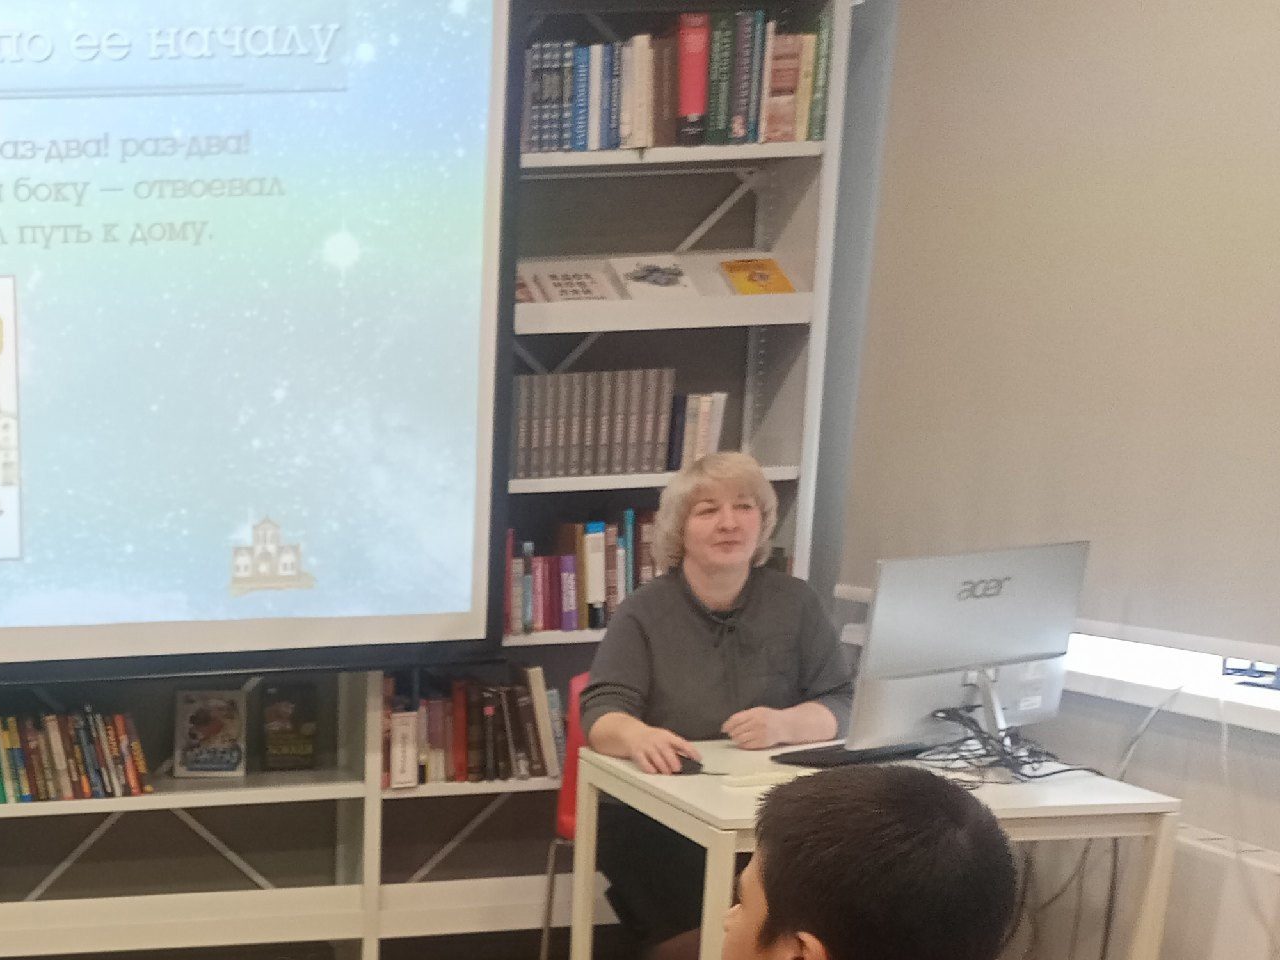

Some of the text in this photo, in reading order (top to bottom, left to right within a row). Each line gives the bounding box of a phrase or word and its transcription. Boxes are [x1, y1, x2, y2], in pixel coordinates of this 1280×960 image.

[71, 27, 132, 61] ее
[147, 21, 341, 64] началу
[119, 129, 251, 163] раз-два!
[13, 177, 91, 207] боку
[133, 175, 287, 200] отвоевал
[17, 221, 93, 251] путь
[101, 222, 121, 245] к
[129, 219, 214, 251] дому.
[957, 576, 1012, 600] acer
